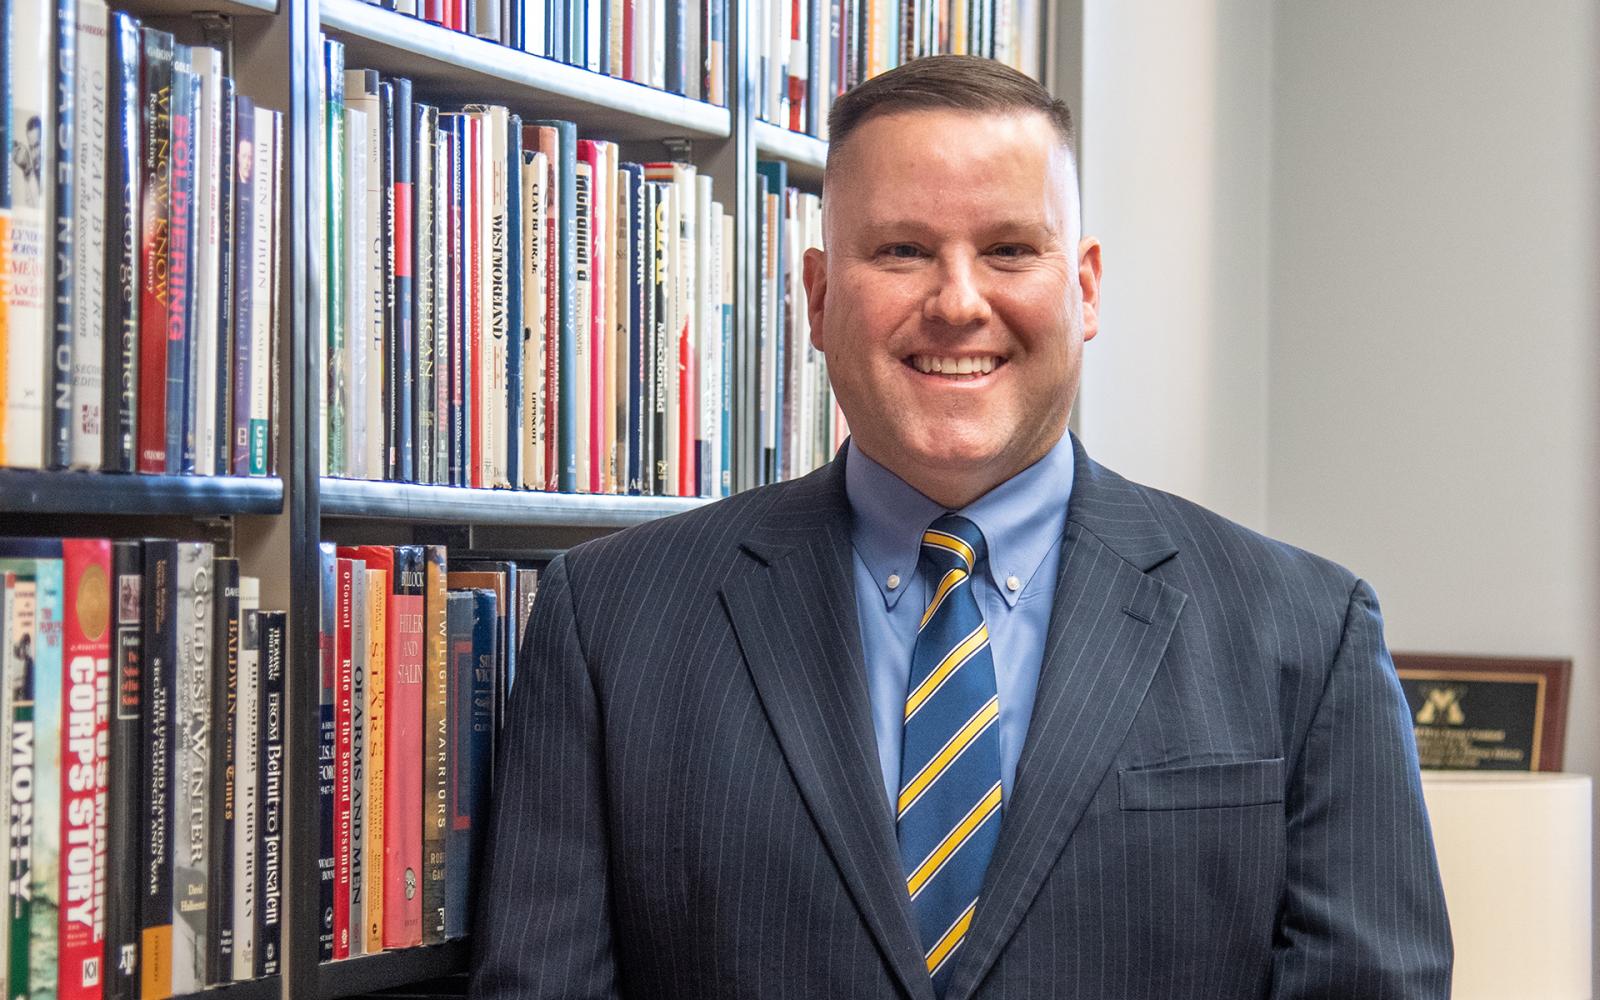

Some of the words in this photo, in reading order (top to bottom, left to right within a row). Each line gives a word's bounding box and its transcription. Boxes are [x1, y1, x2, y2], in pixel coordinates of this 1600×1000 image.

[92, 70, 104, 201] ORDEAL
[148, 94, 158, 168] Rethinking
[157, 86, 171, 129] WE
[157, 132, 171, 207] NOW
[169, 114, 189, 341] SOLDIERING
[531, 183, 540, 216] CLAY
[92, 215, 104, 249] BY
[530, 218, 540, 259] BLAIR,
[567, 219, 577, 277] Elvis's
[79, 214, 89, 338] Reconstruction
[146, 243, 155, 295] History
[154, 218, 170, 308] KNOW
[492, 214, 504, 340] WESTMORELAND
[531, 261, 540, 274] Jr.
[57, 216, 74, 410] NATION
[92, 267, 103, 338] FIRE
[238, 288, 249, 339] White
[423, 247, 434, 378] AMERICAN
[566, 278, 577, 334] Army
[122, 319, 136, 402] Tenet
[237, 345, 249, 397] House
[656, 321, 667, 414] Macdonald
[255, 425, 265, 470] USED
[343, 571, 351, 628] O'Connell
[438, 560, 447, 597] THE
[192, 567, 208, 721] COLDEST
[273, 628, 281, 669] THOMAS
[400, 614, 424, 634] HITLER
[403, 641, 418, 657] AND
[227, 618, 239, 714] BALDWIN
[343, 658, 351, 691] Ride
[354, 665, 363, 703] OF
[399, 664, 423, 684] STALIN
[438, 607, 447, 706] TWILIGHT
[95, 658, 110, 725] THE
[152, 656, 161, 737] SECURITY
[158, 688, 168, 722] THE
[268, 691, 280, 741] FROM
[343, 699, 351, 713] of
[370, 641, 380, 758] STARS
[67, 656, 96, 792] CORPS
[226, 716, 234, 733] OF
[226, 736, 234, 761] THE
[343, 721, 351, 744] the
[353, 706, 363, 780] ARMS
[94, 730, 109, 791] U.S.
[151, 740, 160, 816] COUNCIL
[157, 728, 167, 789] UNITED
[181, 770, 190, 795] WAR
[266, 745, 283, 805] Beirut
[342, 751, 351, 802] Second
[437, 717, 447, 829] WARRIORS
[9, 724, 35, 903] MONTY
[190, 725, 208, 866] WINTER
[224, 765, 236, 821] Times
[246, 786, 254, 844] HARRY
[267, 807, 279, 833] TO
[353, 787, 363, 841] AND
[151, 820, 159, 855] AND
[157, 794, 167, 865] NATIONS
[341, 810, 350, 884] Horseman
[66, 798, 95, 928] STORY
[92, 792, 107, 944] MARINE
[150, 859, 158, 896] WAR
[245, 848, 254, 919] TRUMAN
[264, 835, 281, 925] Jerusalem
[352, 847, 362, 905] MEN
